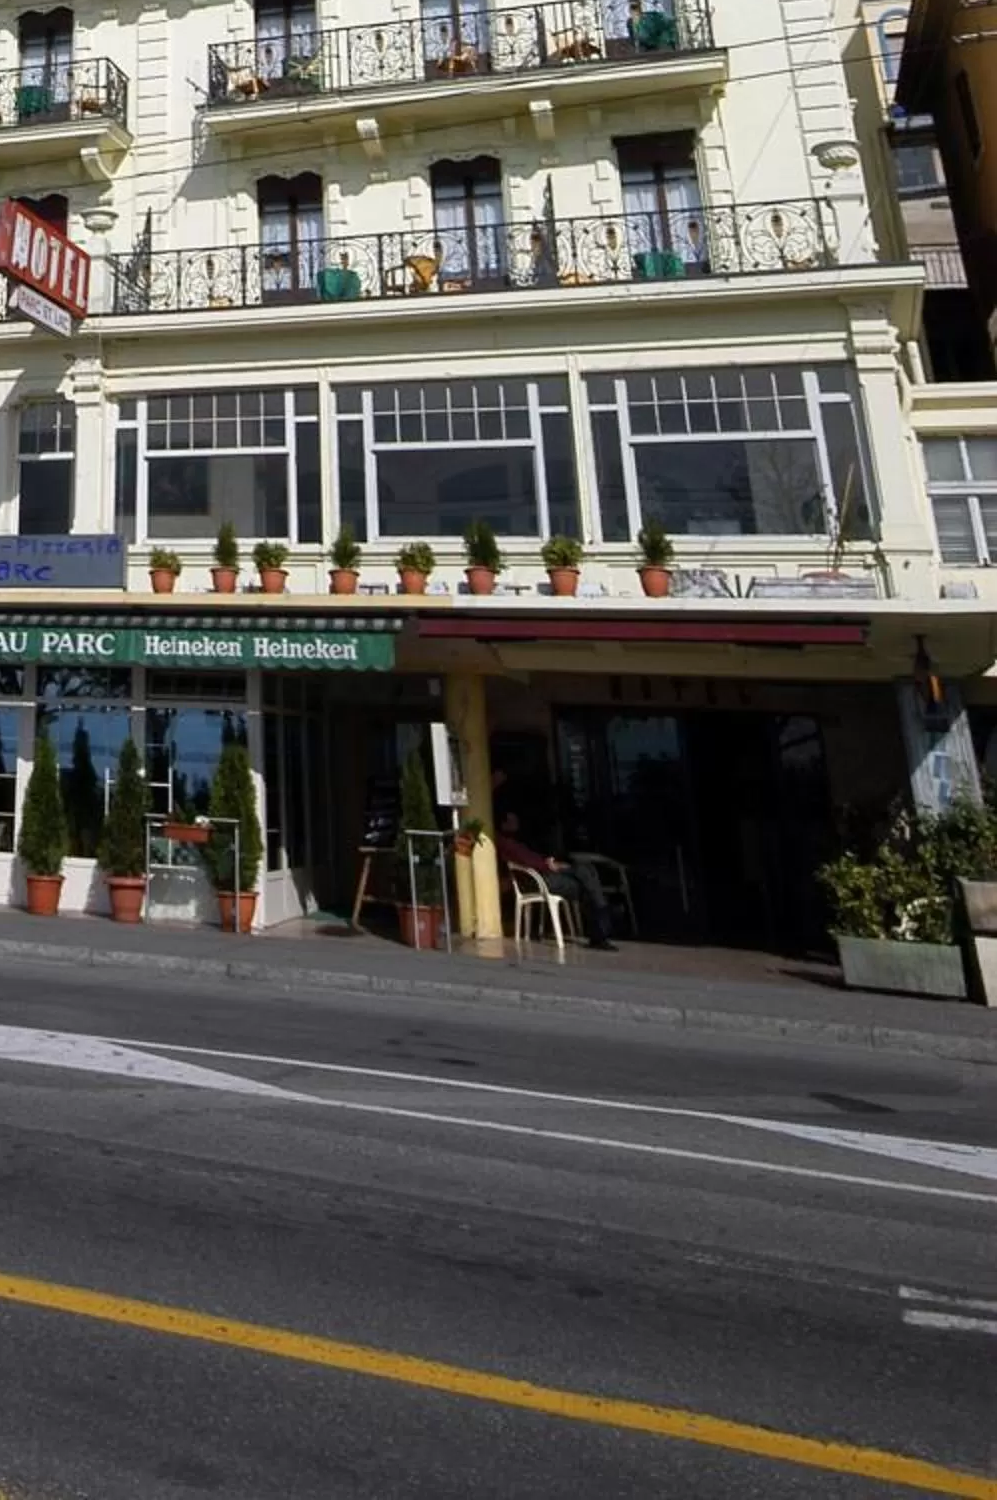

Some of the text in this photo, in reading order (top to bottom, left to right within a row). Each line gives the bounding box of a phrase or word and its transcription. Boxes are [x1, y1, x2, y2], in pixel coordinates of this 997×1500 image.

[10, 211, 87, 309] HOTEL
[42, 632, 116, 655] PARC
[144, 635, 243, 658] Heineken
[252, 637, 358, 661] Heineken
